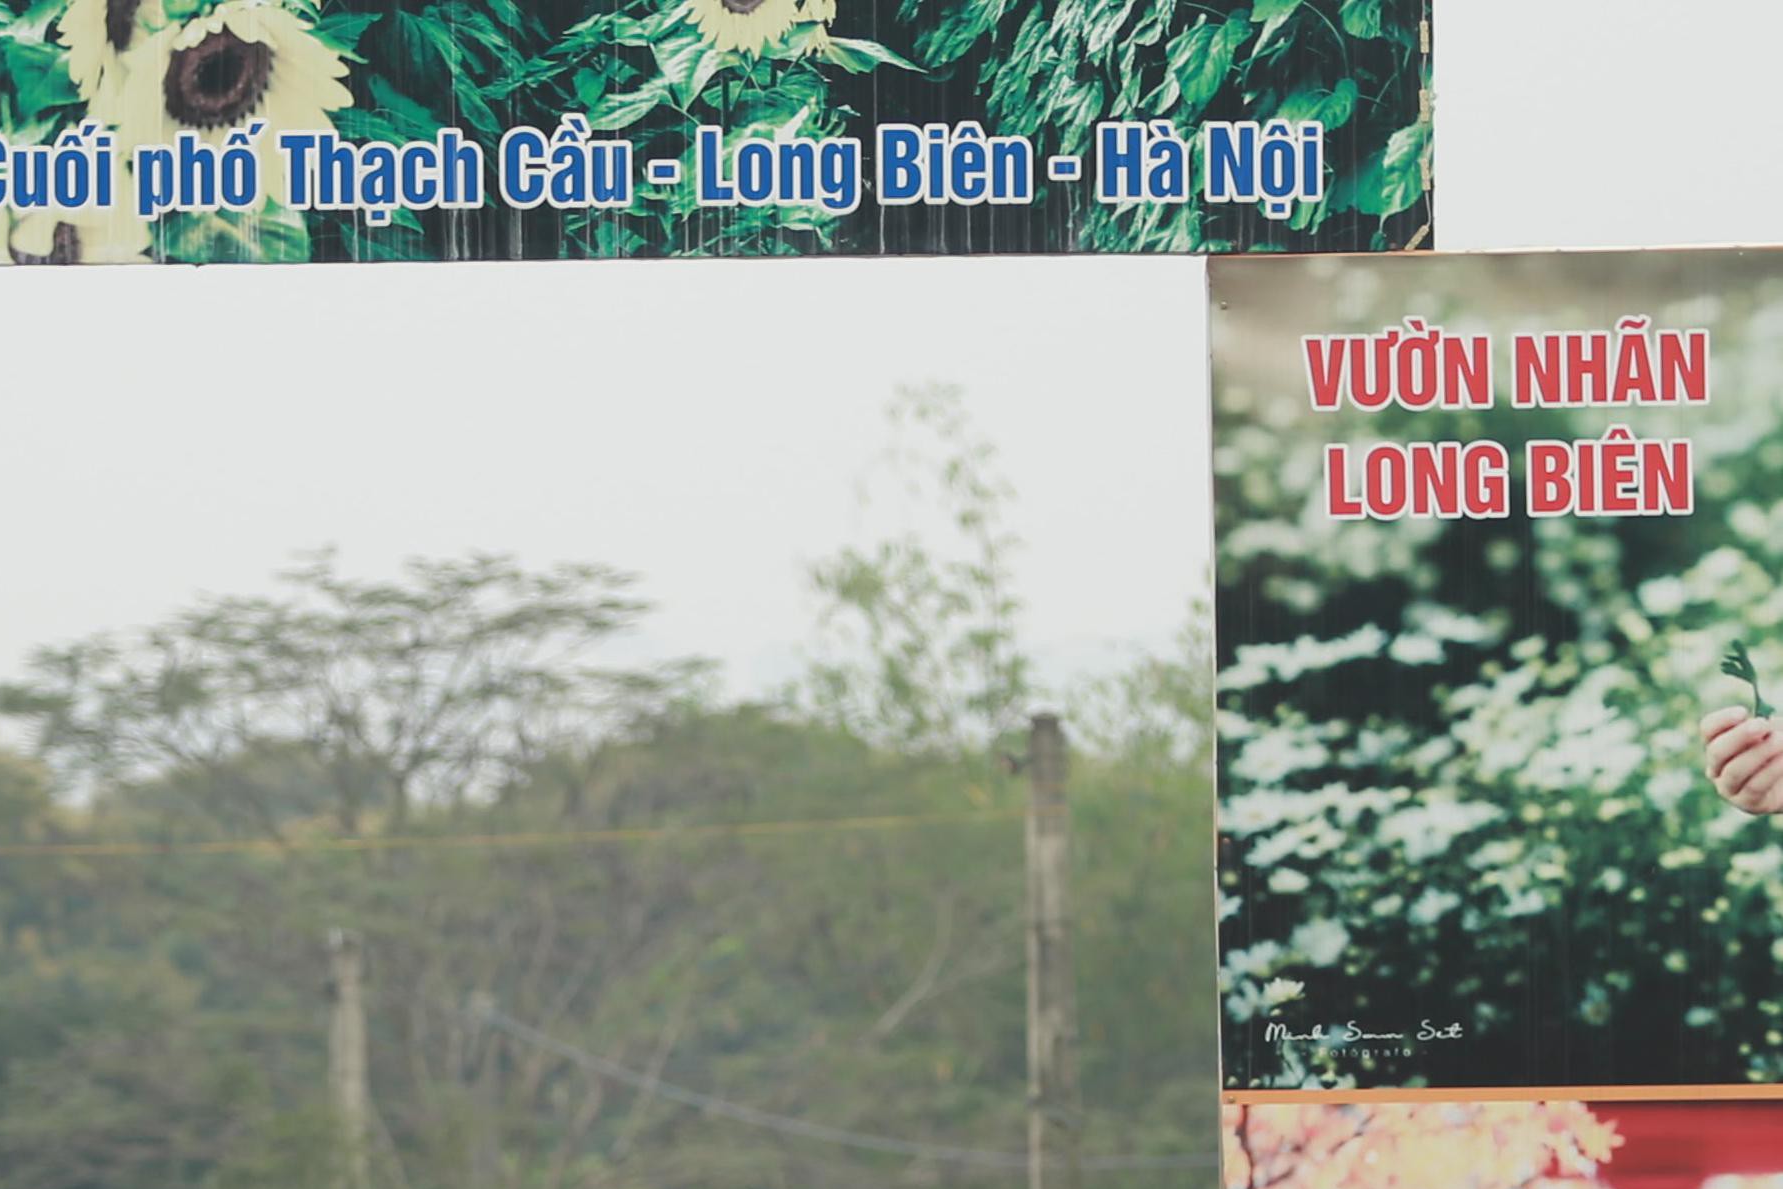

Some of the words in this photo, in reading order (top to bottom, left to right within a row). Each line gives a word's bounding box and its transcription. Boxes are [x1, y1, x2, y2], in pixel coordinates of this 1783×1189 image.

[137, 123, 265, 217] phố
[279, 131, 481, 221] Thạch
[502, 117, 629, 205] Cầu
[699, 129, 859, 210] Long
[879, 122, 1031, 202] Biên
[1100, 122, 1185, 200] Hà
[1207, 123, 1320, 215] Nội
[1304, 319, 1490, 407] VƯỜN
[1515, 317, 1707, 404] NHÃN
[1327, 445, 1505, 516] LONG
[1529, 427, 1691, 513] BIÊN
